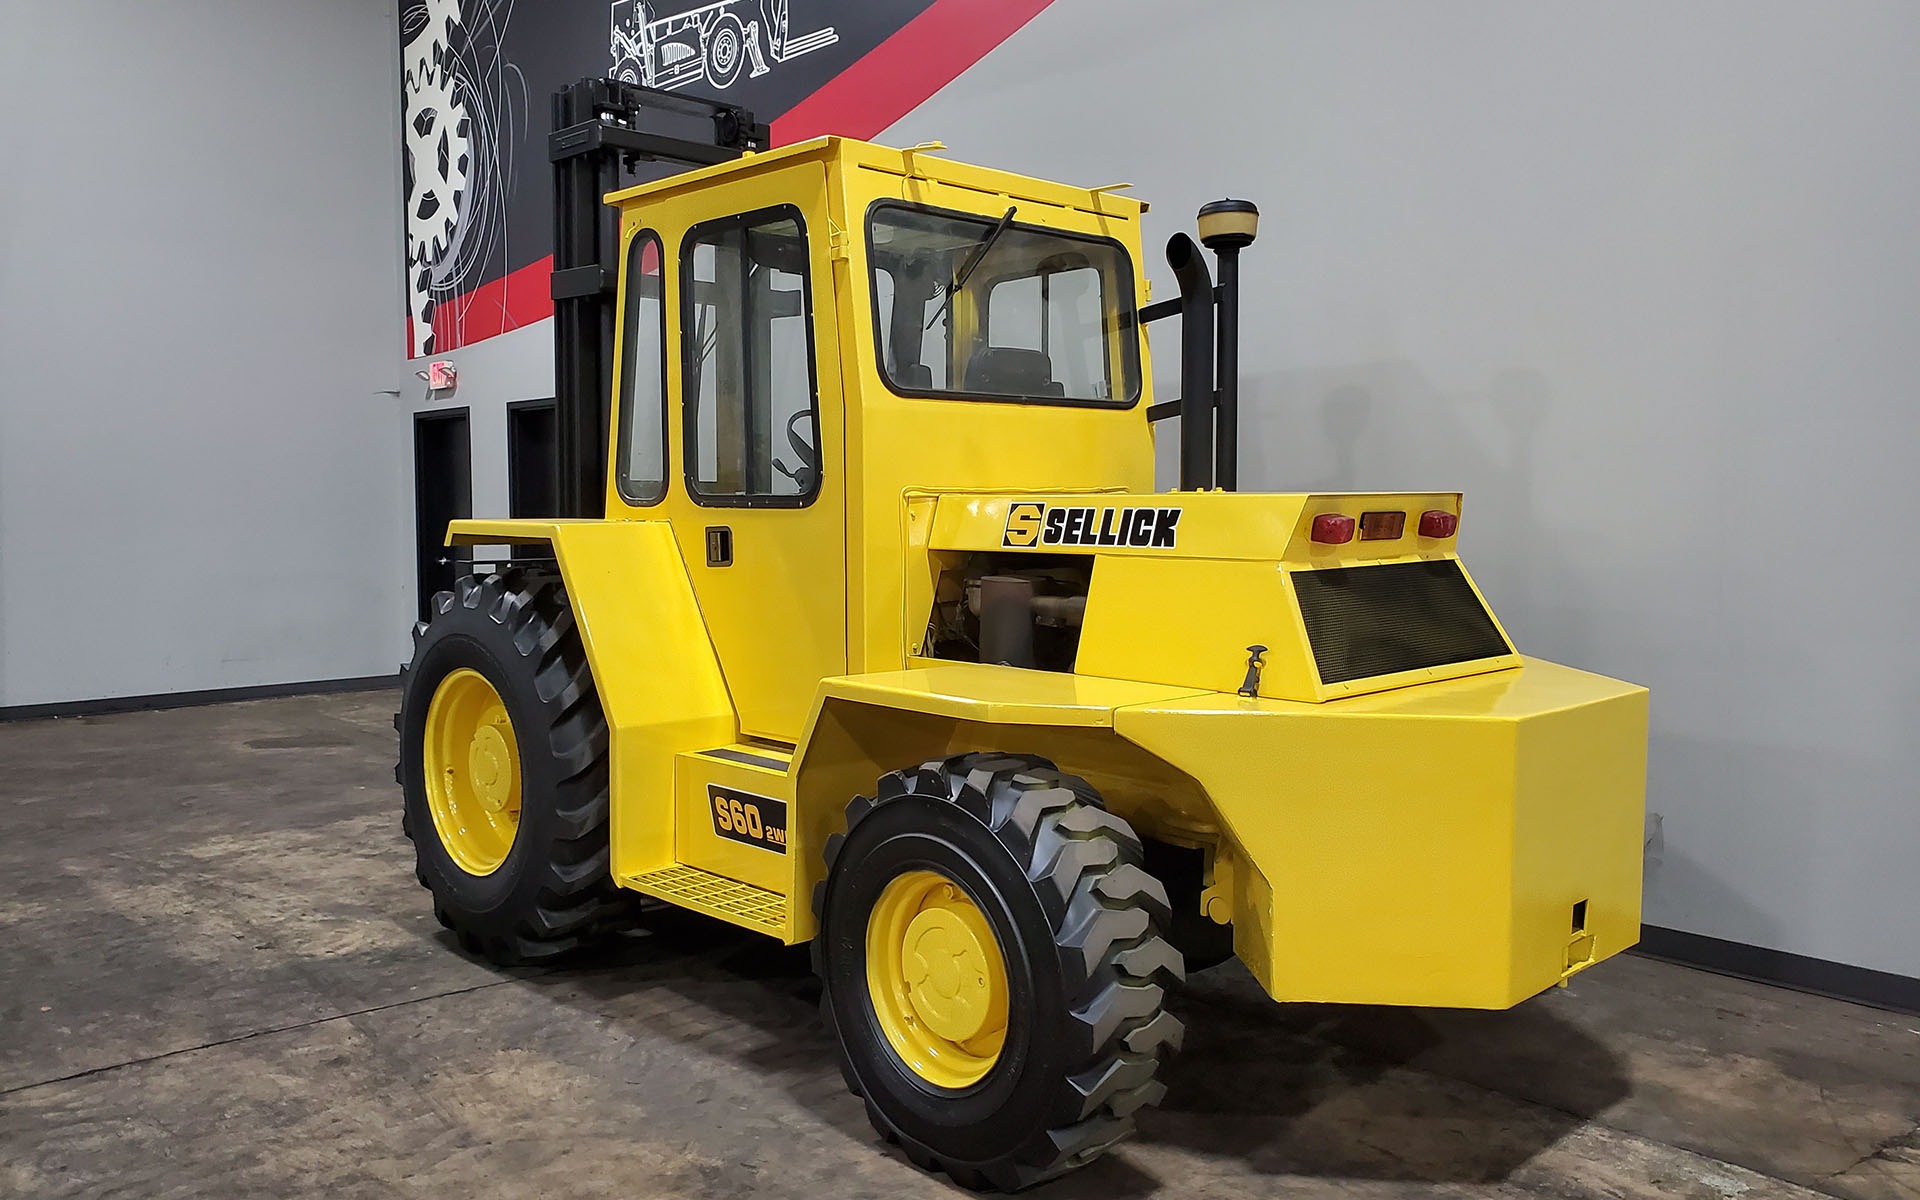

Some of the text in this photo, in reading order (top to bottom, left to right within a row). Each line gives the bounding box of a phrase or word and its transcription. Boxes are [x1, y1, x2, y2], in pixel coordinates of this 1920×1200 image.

[1043, 508, 1182, 548] SELLICK
[714, 796, 787, 844] S60 2W
